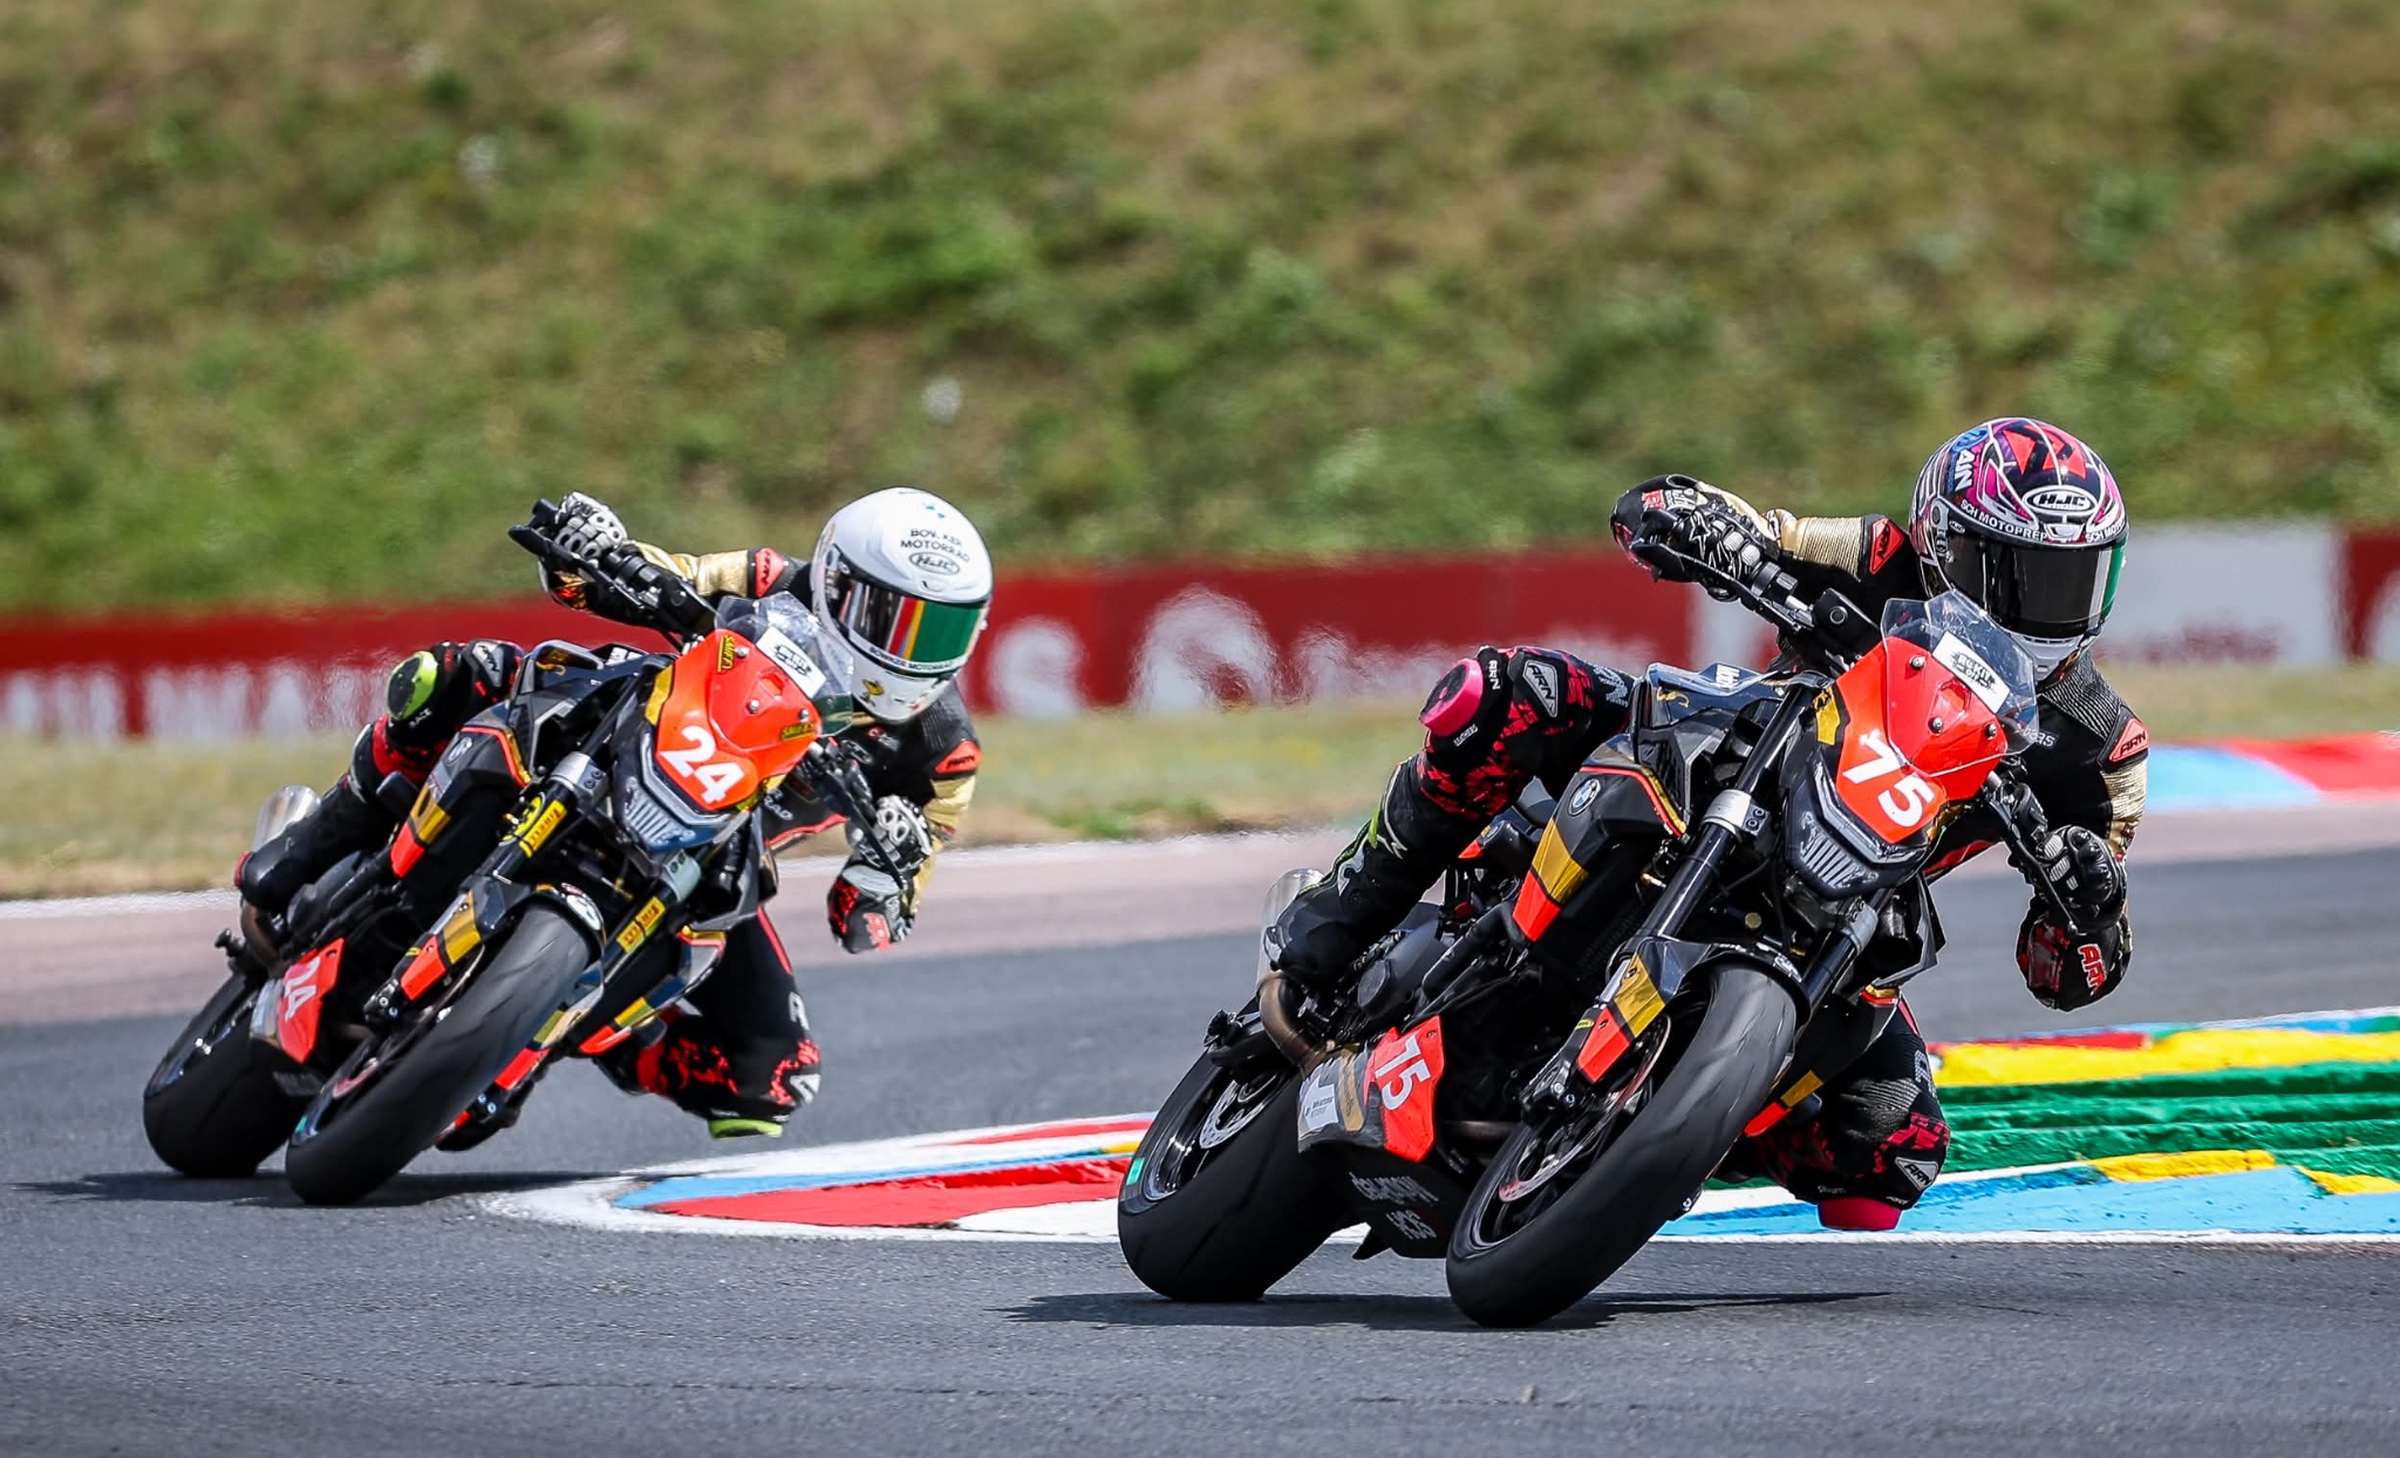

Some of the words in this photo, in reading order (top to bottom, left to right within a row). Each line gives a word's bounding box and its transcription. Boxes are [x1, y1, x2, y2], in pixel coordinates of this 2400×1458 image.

[2038, 493, 2087, 507] HJC
[1979, 510, 2047, 542] MOTOPREP
[1488, 659, 1502, 690] ARN
[1528, 663, 1556, 702] ARN
[2119, 729, 2147, 757] ARN
[660, 724, 746, 805] 24
[1842, 729, 1935, 828] 75
[284, 956, 322, 1022] 24
[1375, 1034, 1431, 1111] 75
[1903, 1162, 1933, 1186] ARN
